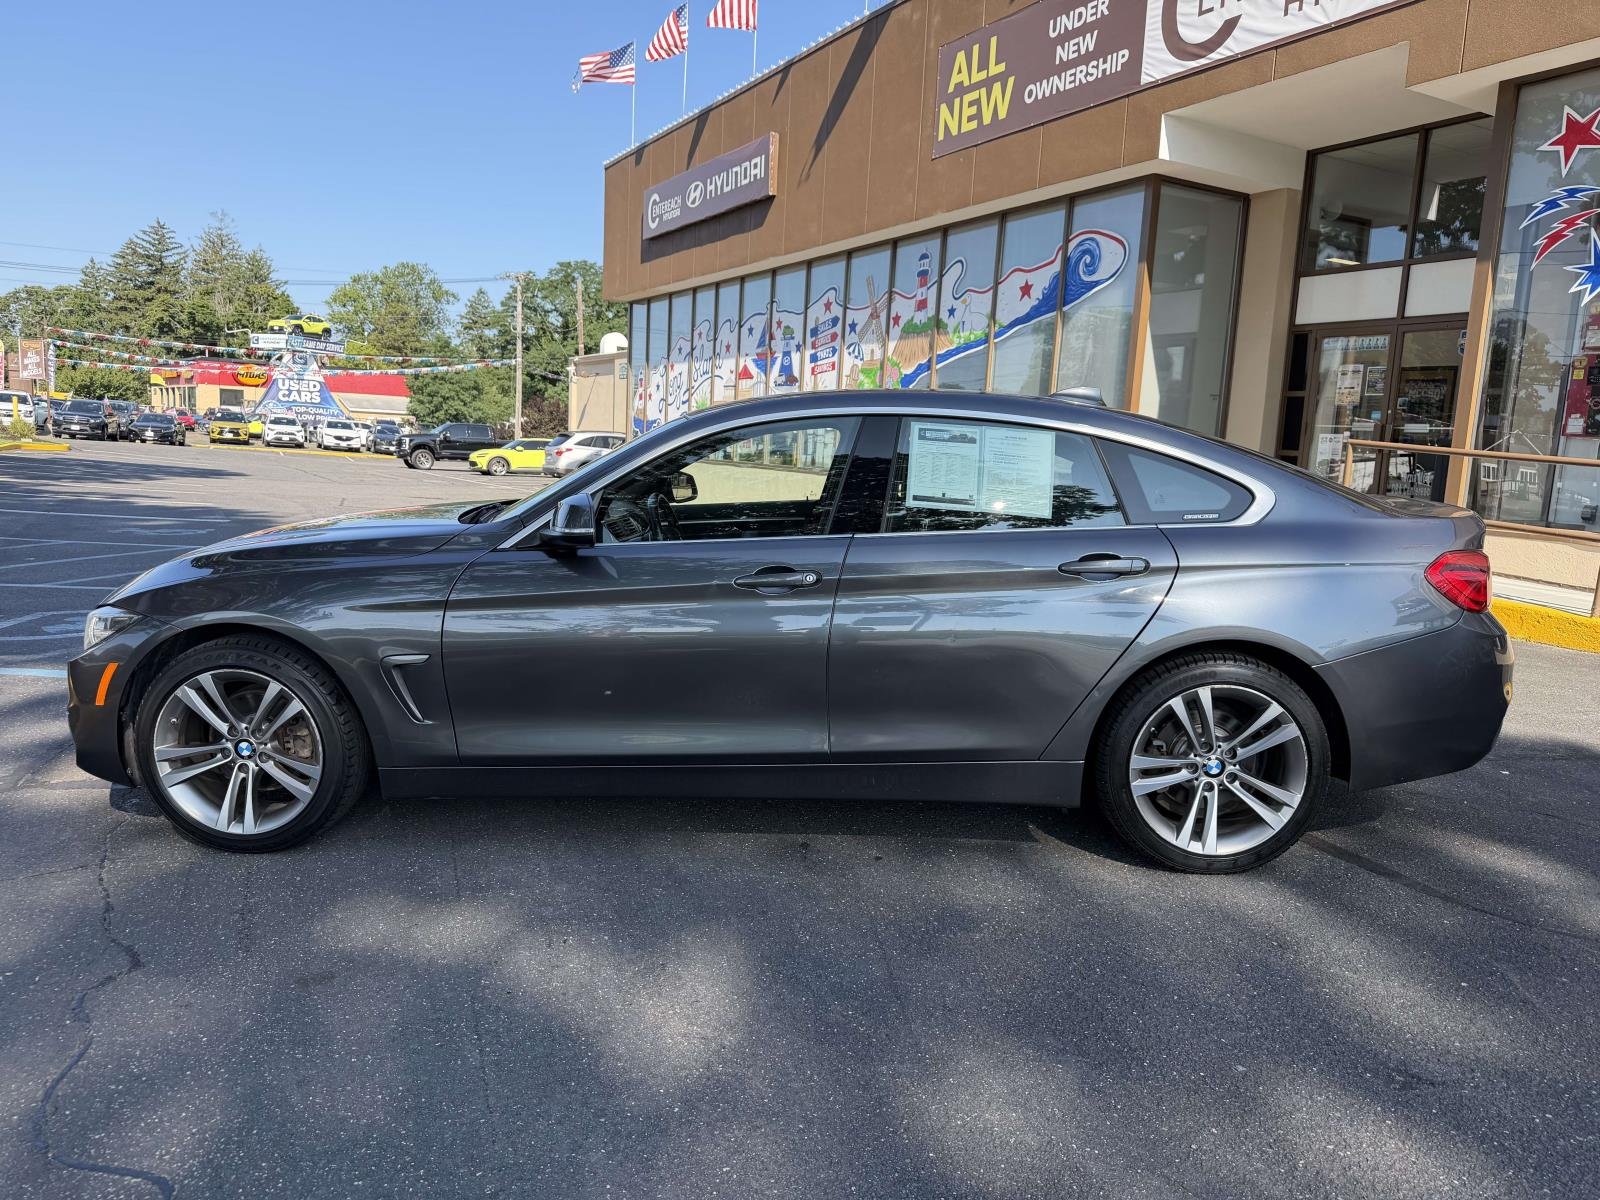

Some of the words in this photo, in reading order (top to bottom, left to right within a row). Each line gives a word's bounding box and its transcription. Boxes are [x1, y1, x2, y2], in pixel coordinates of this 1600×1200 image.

[1048, 0, 1109, 38] UNDER
[947, 35, 1006, 94] ALL
[1055, 30, 1098, 65] NEW
[1024, 49, 1129, 104] OWNERSHIP
[937, 75, 1015, 142] NEW
[706, 154, 765, 200] HYUNDAI
[303, 340, 317, 349] SAME
[317, 342, 326, 350] DAY
[277, 378, 321, 392] USED
[277, 390, 321, 404] CARS
[291, 406, 339, 415] TOP-QUALITY
